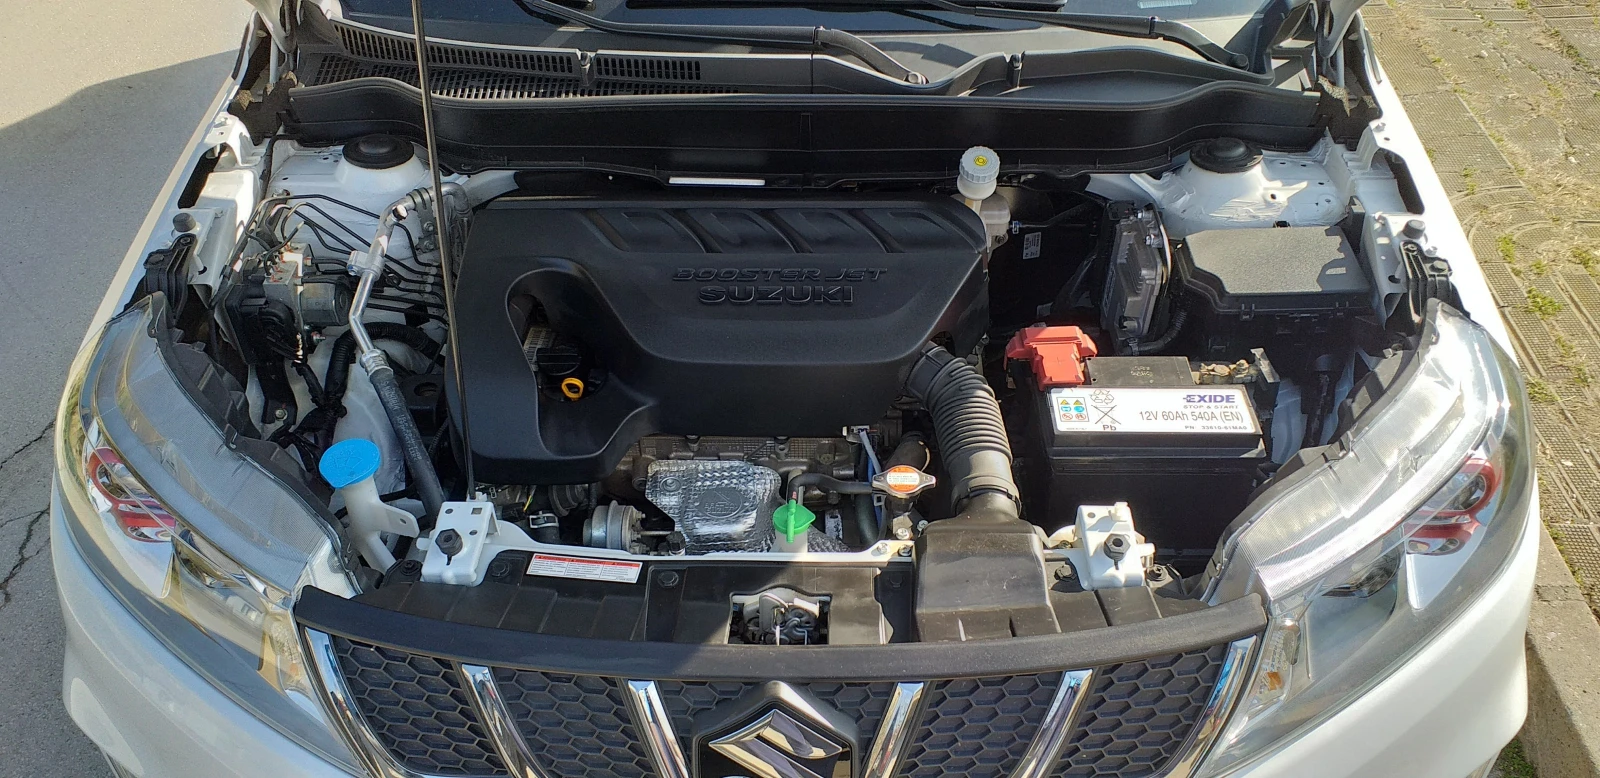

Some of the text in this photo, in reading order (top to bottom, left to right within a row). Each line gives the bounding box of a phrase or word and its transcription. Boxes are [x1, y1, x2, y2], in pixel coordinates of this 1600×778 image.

[672, 267, 888, 281] BOOSTER JET
[698, 285, 854, 304] SUZUKI
[1183, 394, 1236, 403] EXIDE
[1139, 410, 1244, 424] 12V 60Ah 540A (EN)
